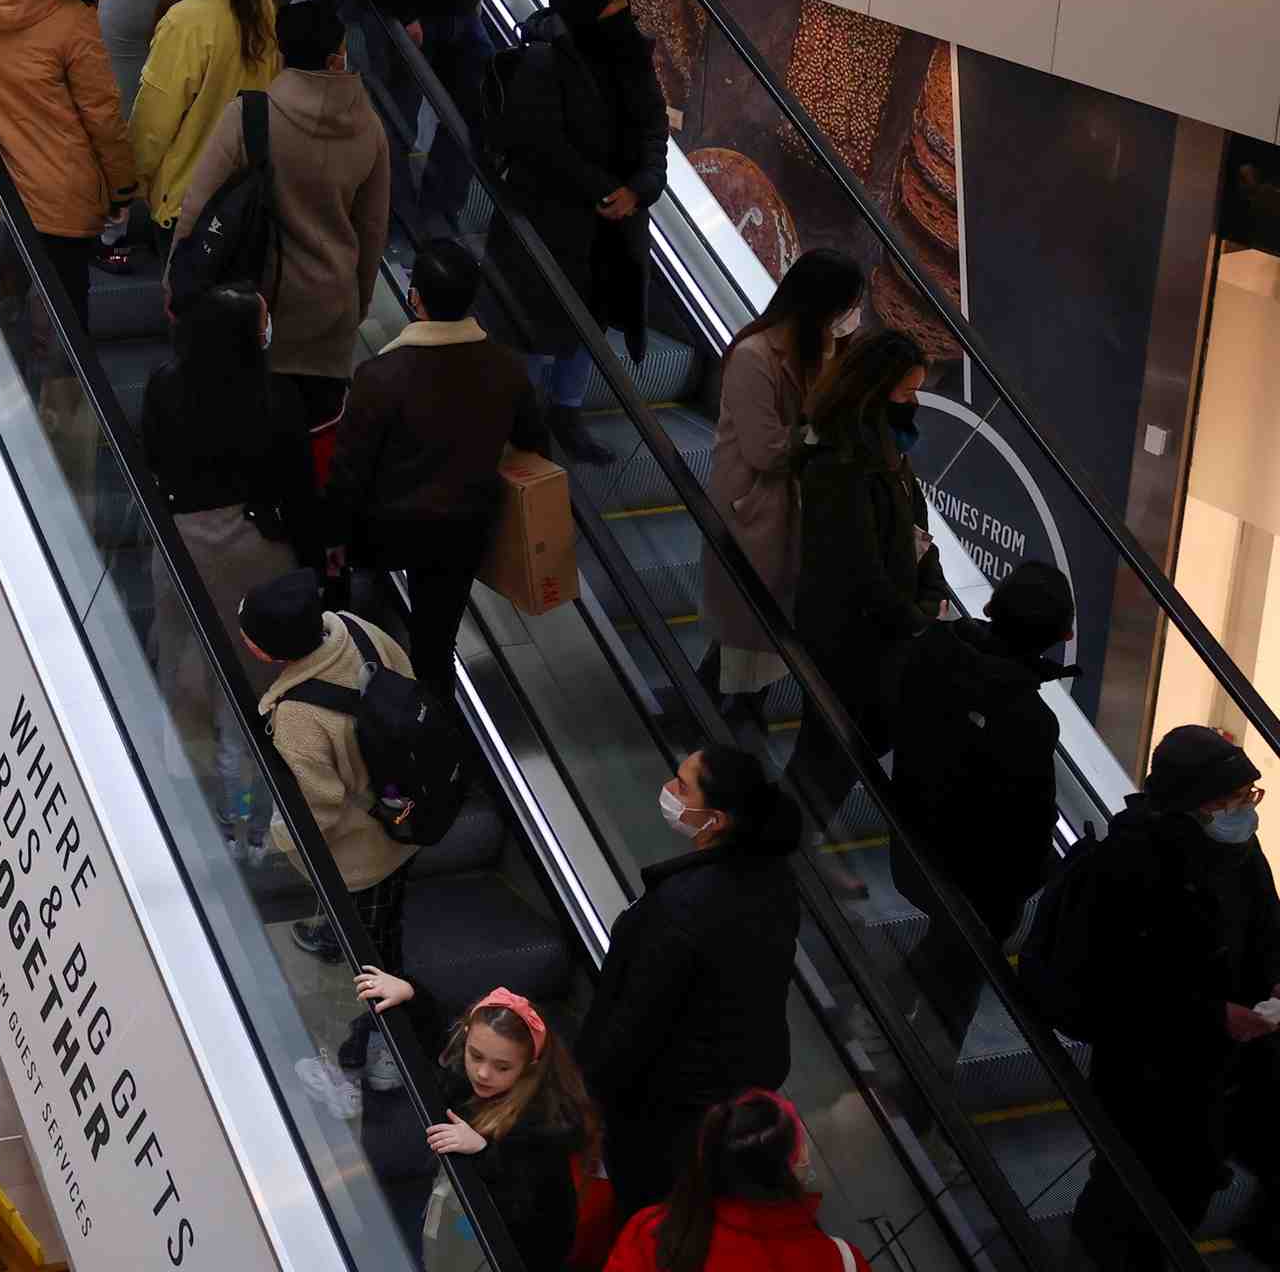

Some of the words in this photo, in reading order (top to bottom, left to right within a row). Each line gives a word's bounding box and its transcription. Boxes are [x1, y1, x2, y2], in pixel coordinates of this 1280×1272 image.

[981, 513, 1026, 557] FROM
[9, 693, 98, 908] WHERE
[7, 1010, 45, 1096] GUEST
[40, 1102, 93, 1239] SERVICES
[39, 884, 63, 938] &
[62, 941, 112, 1056] BIG
[110, 1068, 195, 1267] GIFTS
